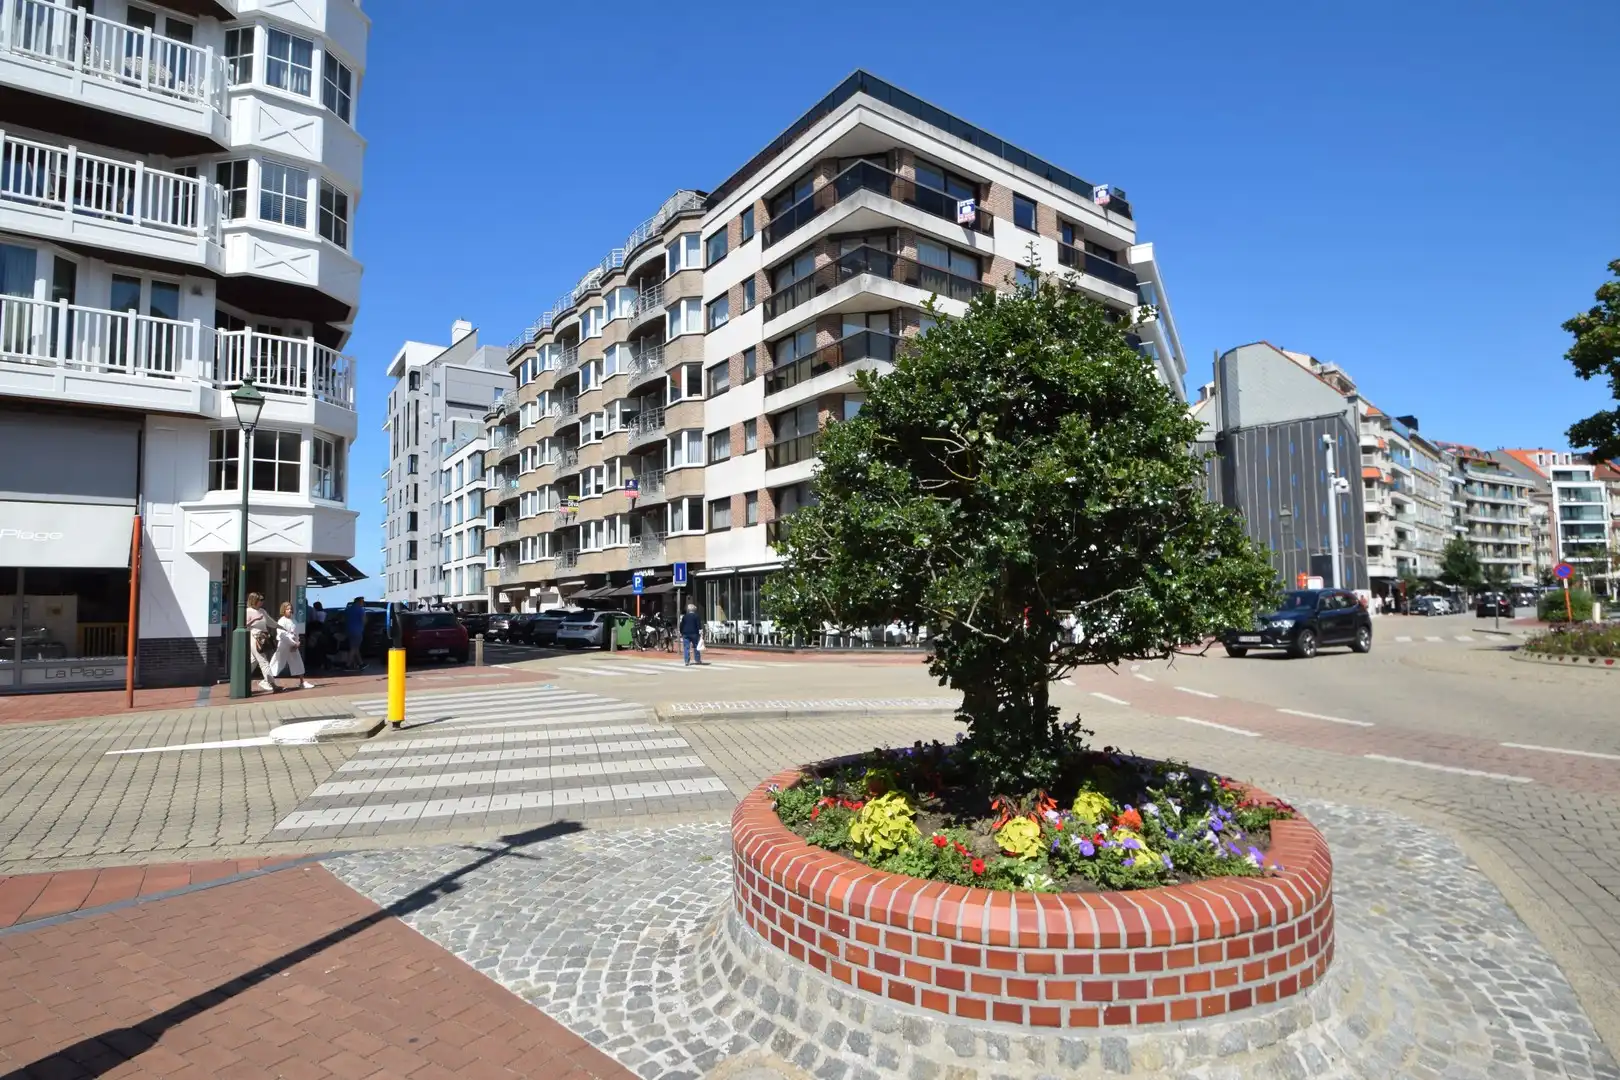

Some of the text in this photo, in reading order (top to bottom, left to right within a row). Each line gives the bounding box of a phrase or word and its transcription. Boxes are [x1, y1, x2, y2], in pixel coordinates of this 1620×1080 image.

[0, 529, 63, 543] Plage
[635, 577, 641, 588] P
[45, 667, 114, 679] La Plage
